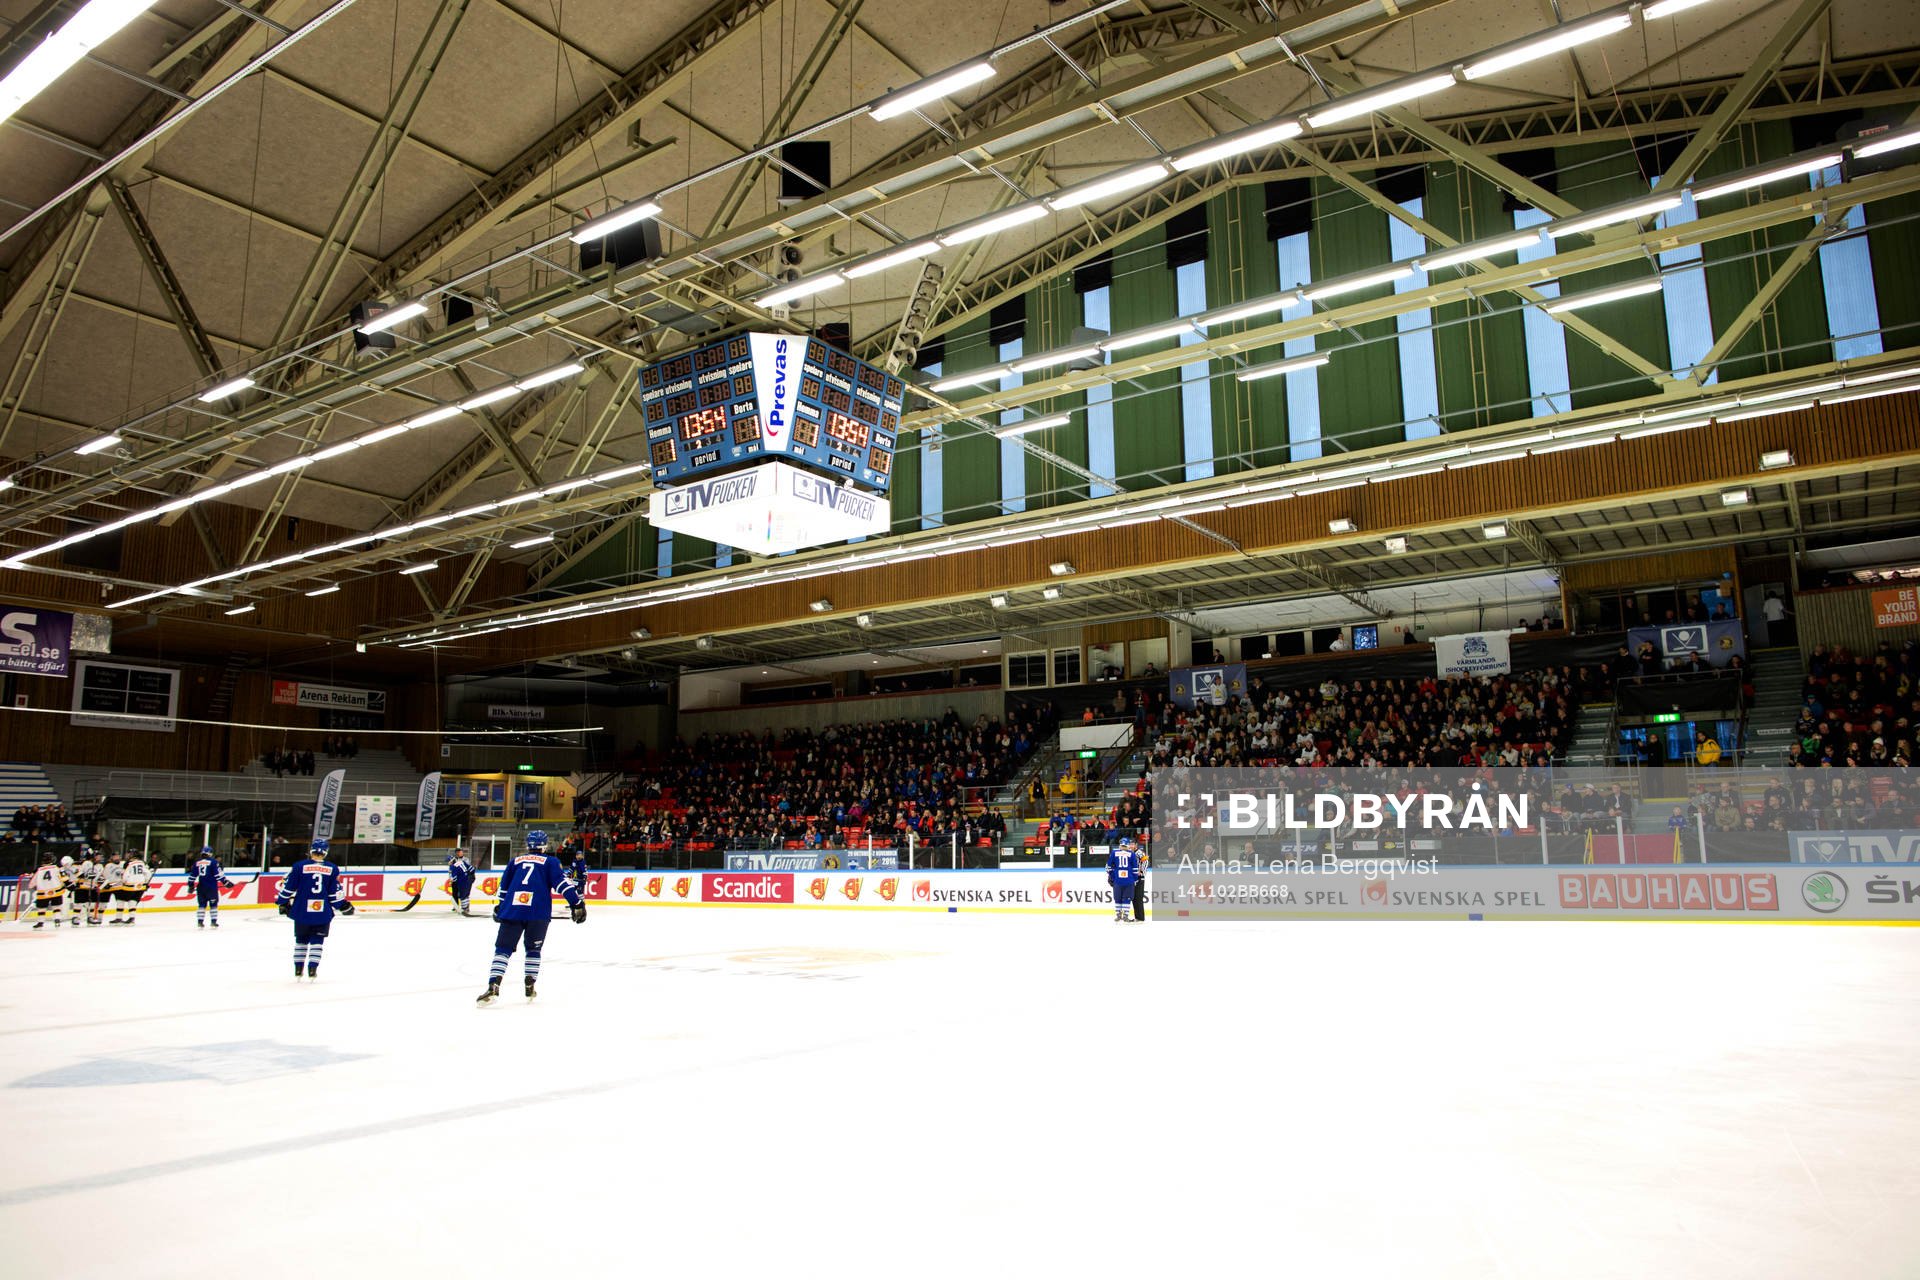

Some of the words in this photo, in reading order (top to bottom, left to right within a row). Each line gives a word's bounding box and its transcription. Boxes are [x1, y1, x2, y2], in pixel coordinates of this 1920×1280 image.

[665, 379, 693, 395] utvisning
[698, 369, 727, 385] utvisning
[728, 360, 753, 375] spelare
[770, 339, 787, 426] Prevas
[733, 402, 754, 415] Borta
[796, 401, 820, 418] Hemma
[683, 406, 727, 438] 13:54
[648, 426, 672, 439] Hemma
[830, 412, 870, 449] 13:54
[875, 433, 892, 448] Borta
[694, 451, 717, 467] period
[831, 456, 853, 471] period
[711, 475, 759, 507] PUCKEN
[837, 491, 876, 522] PUCKEN
[1899, 590, 1915, 601] BE
[1884, 600, 1916, 613] YOUR
[1878, 611, 1918, 625] BRAND
[8, 657, 37, 670] bättre
[38, 662, 66, 673] affär!
[300, 688, 329, 702] Arena
[331, 691, 366, 706] Reklam
[131, 864, 144, 875] 16
[881, 857, 896, 866] 2014
[1118, 856, 1129, 868] 10
[43, 870, 52, 882] 4
[522, 863, 534, 885] 7
[311, 873, 323, 894] 3
[713, 876, 782, 899] Scandic
[1562, 876, 1773, 905] BAUHAUS
[933, 889, 994, 903] SVENSKA
[999, 889, 1033, 904] SPEL
[1304, 890, 1348, 905] SPEL
[1393, 890, 1485, 906] SVENSKA
[1494, 890, 1545, 907] SPEL
